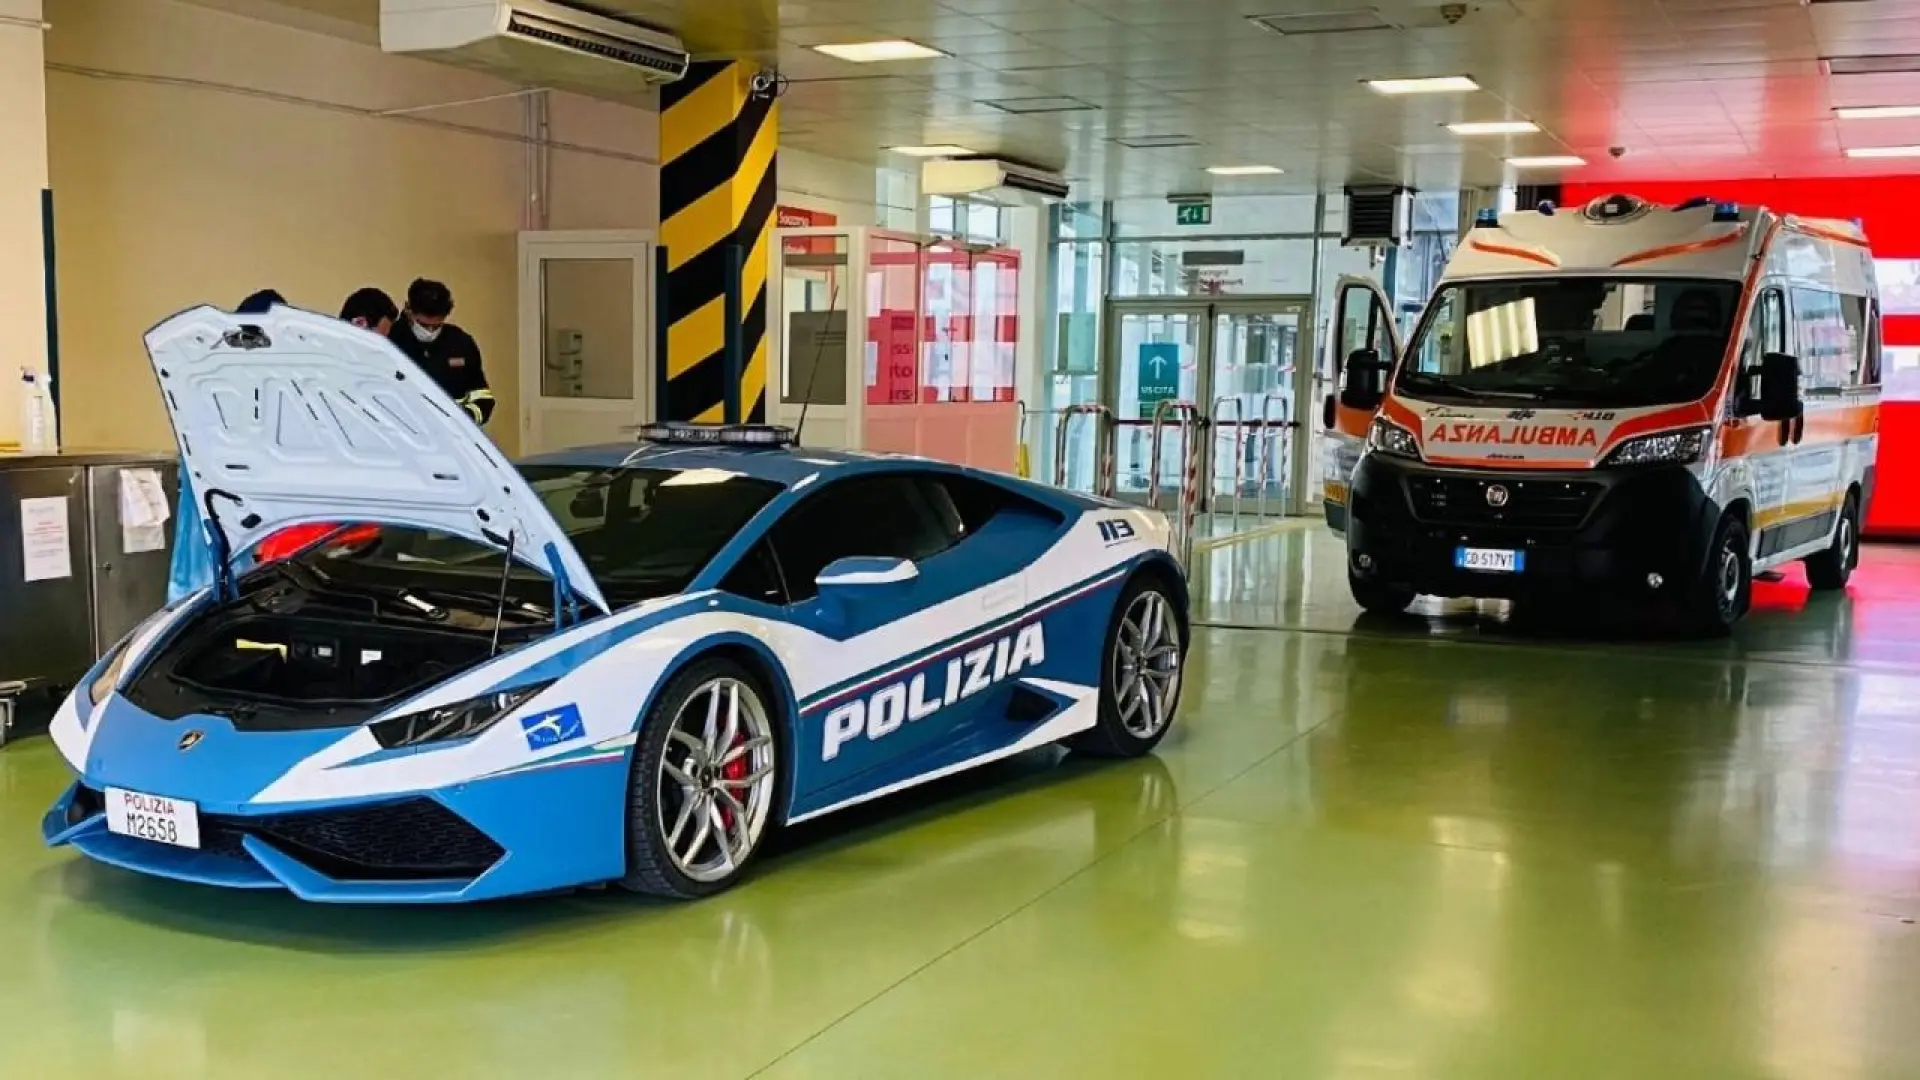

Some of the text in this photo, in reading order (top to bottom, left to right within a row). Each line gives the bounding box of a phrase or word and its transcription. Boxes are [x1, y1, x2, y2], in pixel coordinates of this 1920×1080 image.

[1140, 386, 1175, 394] USCITA
[1096, 518, 1135, 541] 113
[822, 620, 1045, 762] POLIZIA
[124, 793, 175, 814] POLIZIA
[127, 812, 178, 842] M2658
